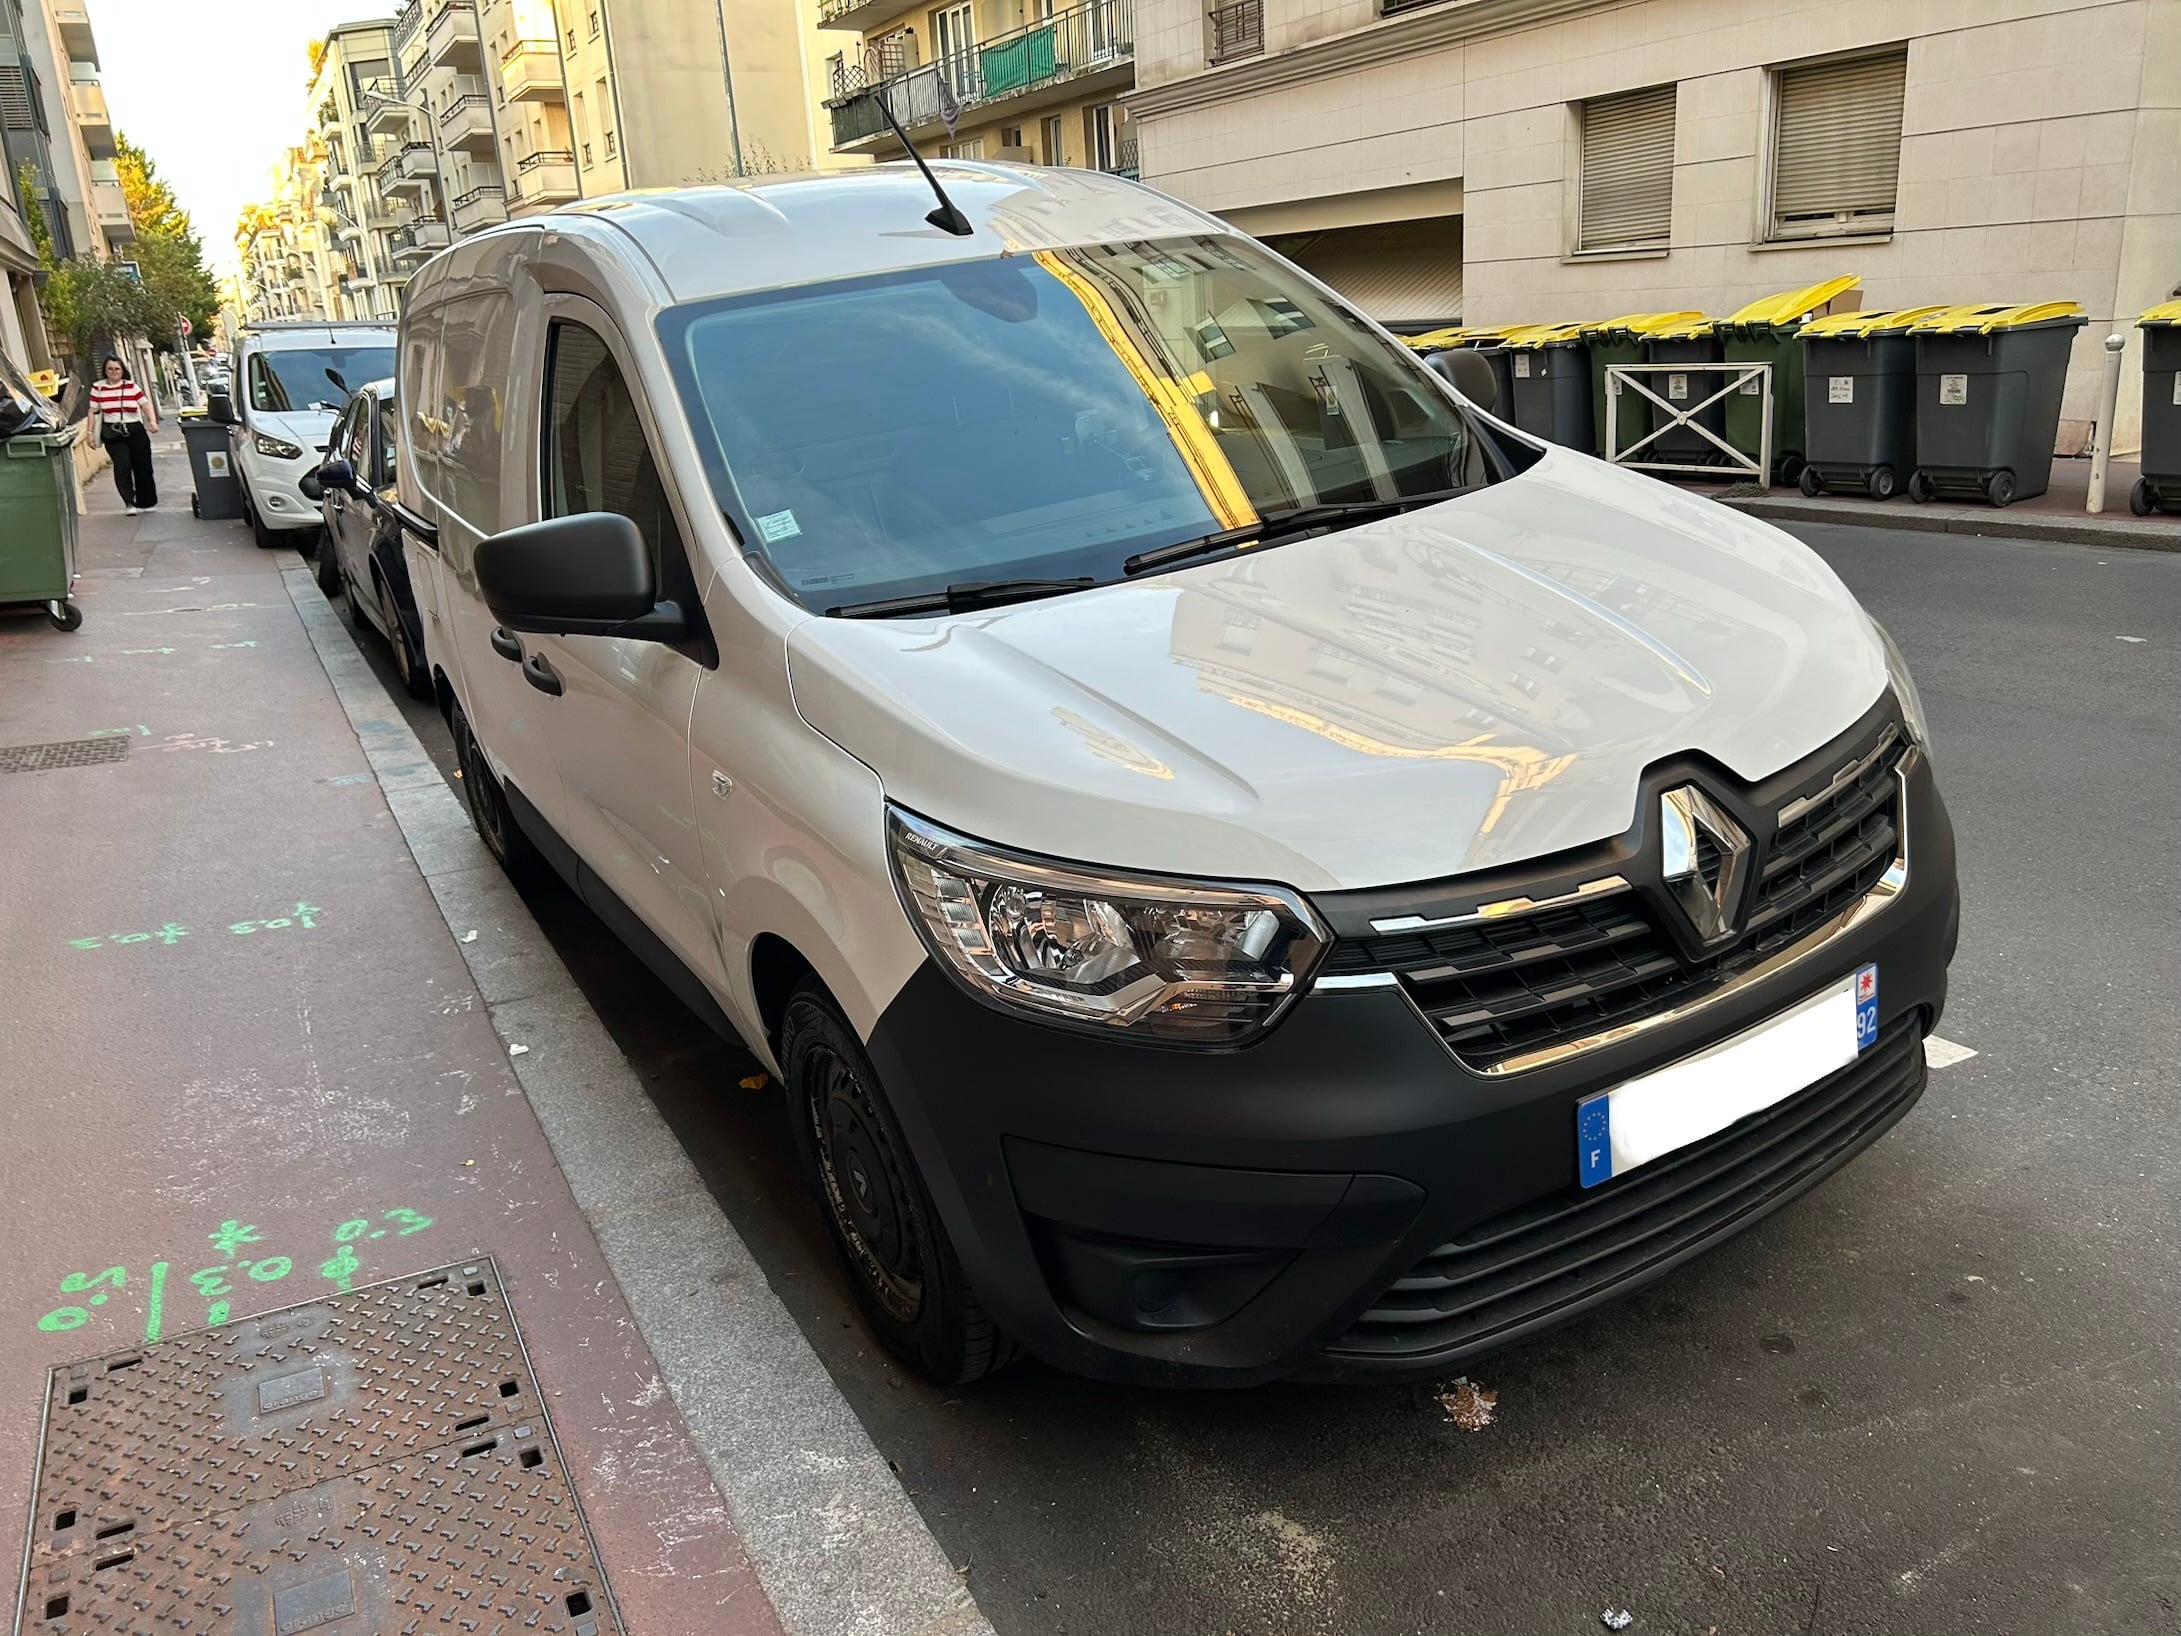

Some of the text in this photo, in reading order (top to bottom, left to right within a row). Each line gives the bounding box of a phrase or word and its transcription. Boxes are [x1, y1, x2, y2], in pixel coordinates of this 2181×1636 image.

[904, 832, 939, 850] RENAULT
[1857, 1005, 1877, 1039] 92
[1590, 1149, 1601, 1168] F
[335, 1207, 434, 1242] 0.3
[262, 1389, 319, 1411] orange
[279, 1600, 348, 1632] orange
